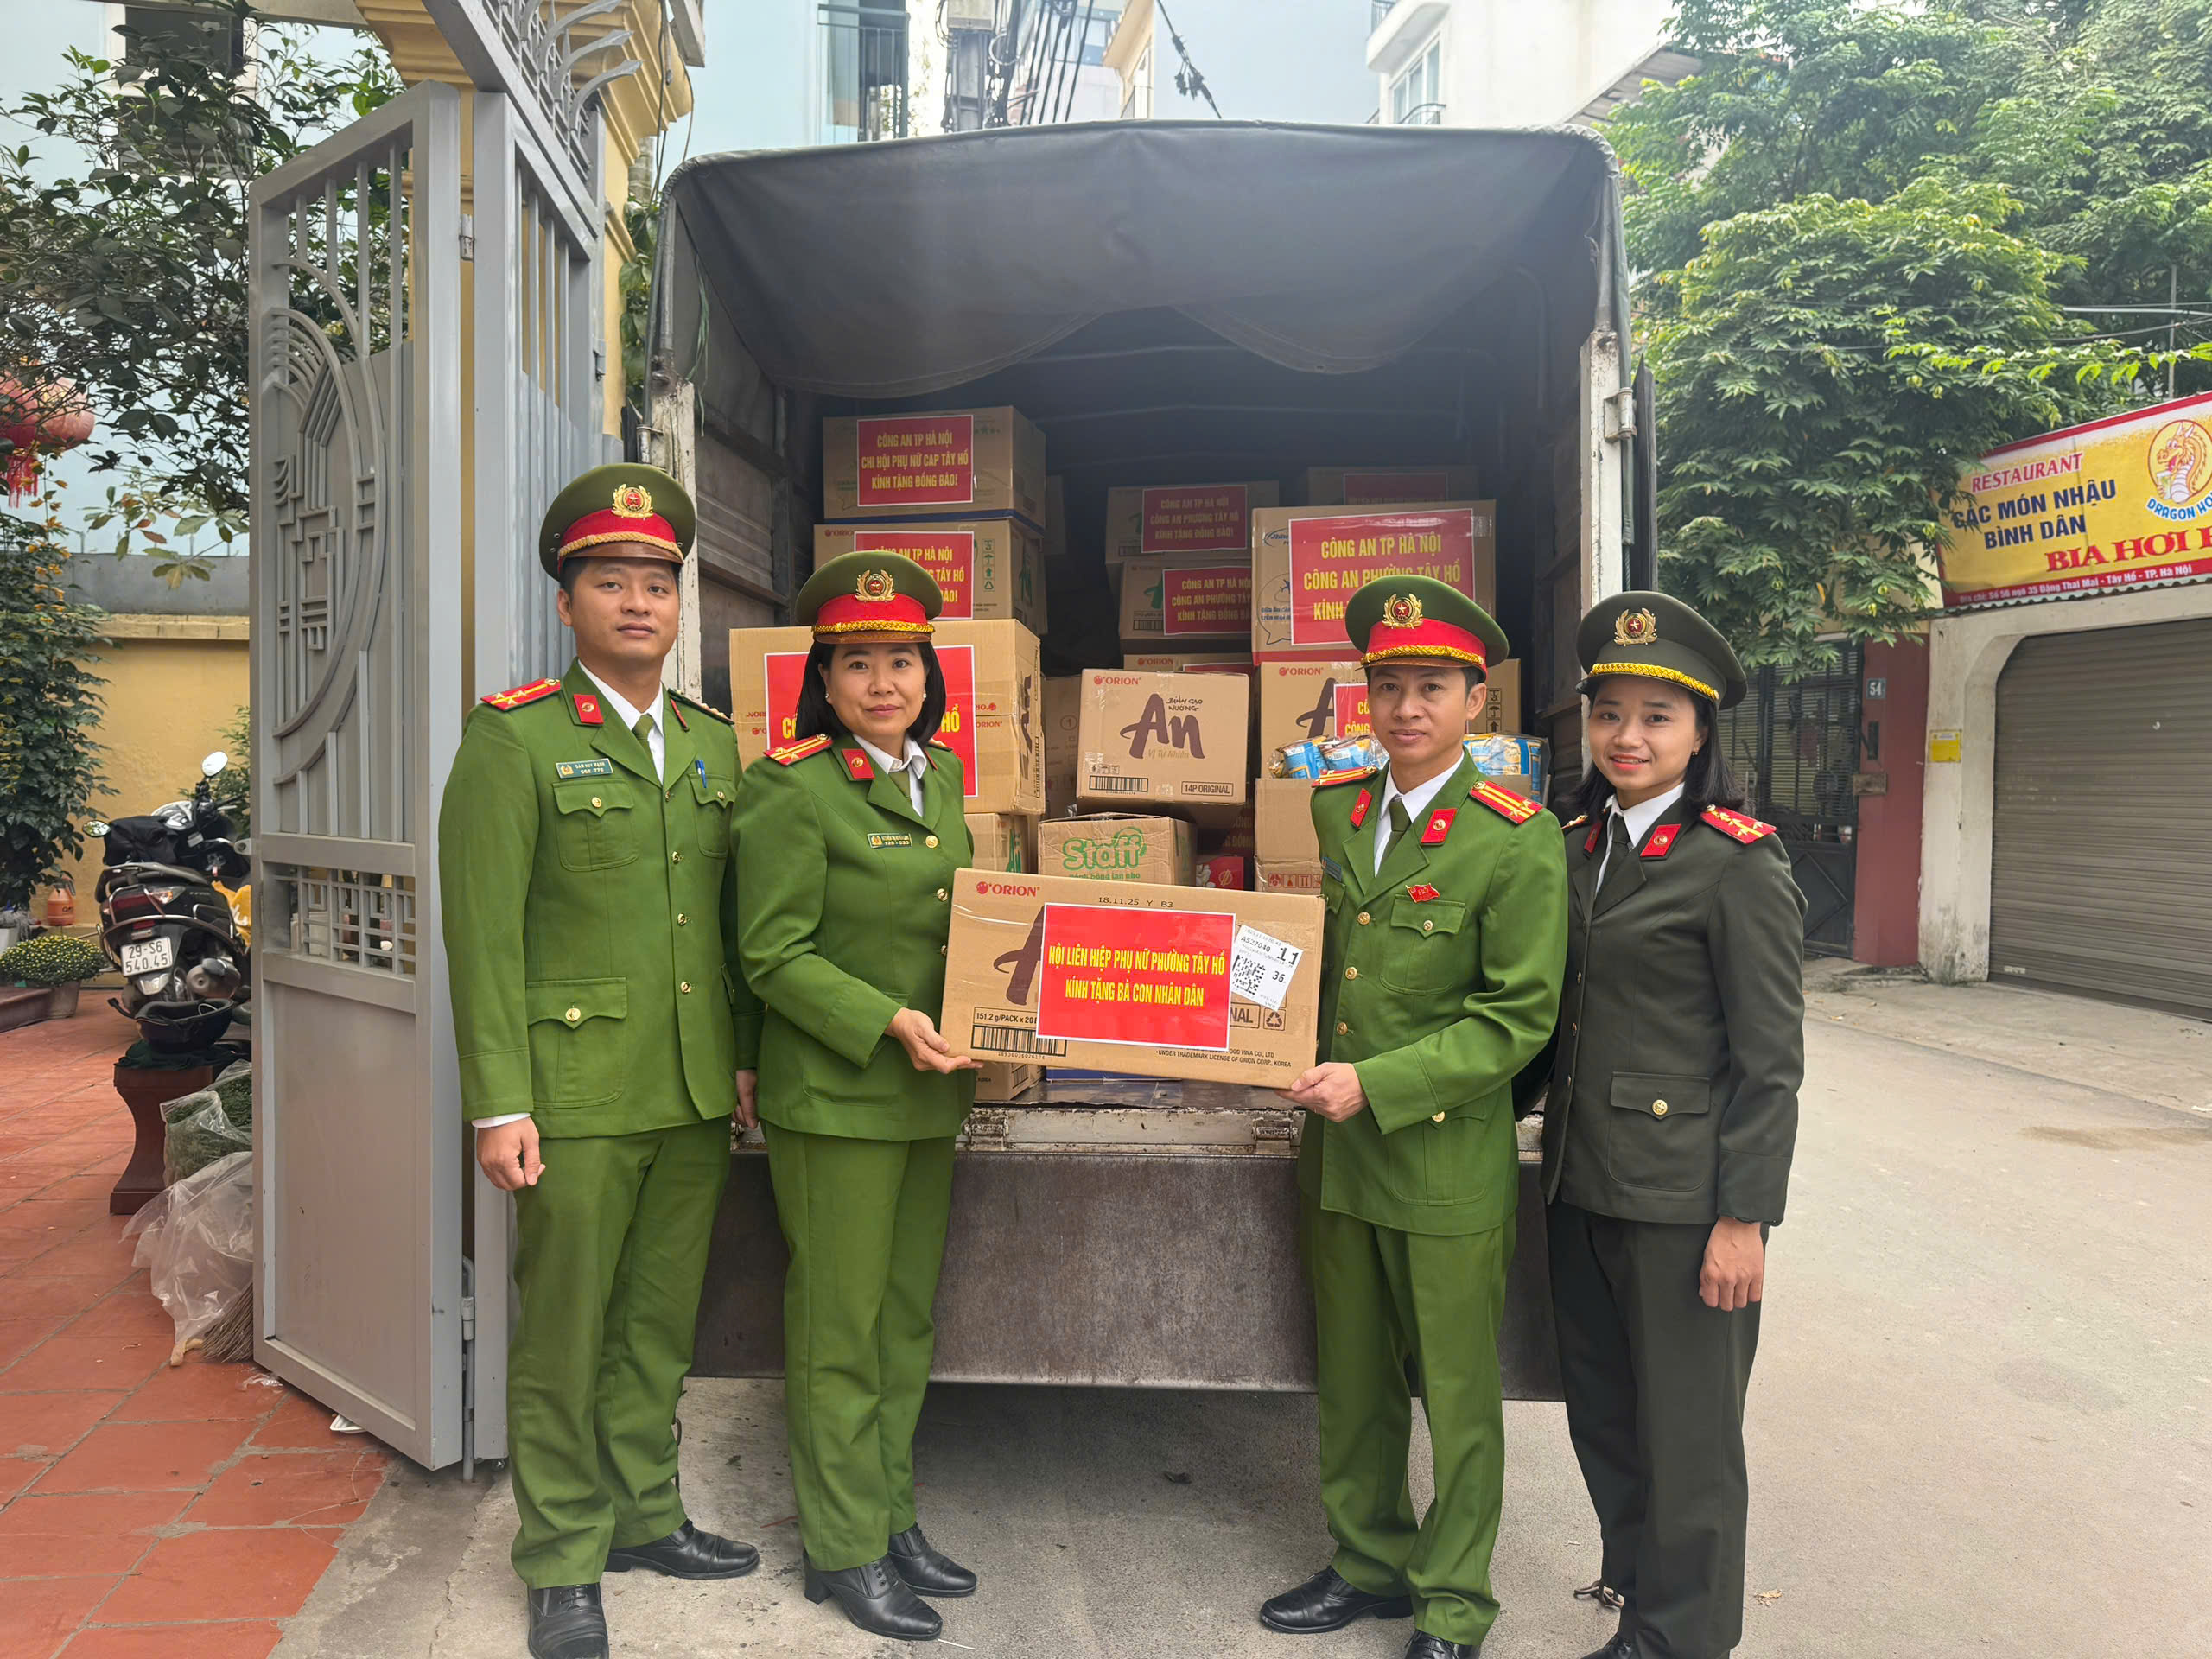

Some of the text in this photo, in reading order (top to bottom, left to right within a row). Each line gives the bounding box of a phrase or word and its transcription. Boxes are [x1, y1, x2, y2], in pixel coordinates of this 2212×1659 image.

[877, 429, 952, 448] CÔNG AN TP HÀ NỘI
[861, 456, 874, 469] CHI
[876, 453, 890, 470] HỘI
[892, 454, 907, 470] PHỤ
[924, 454, 939, 467] CAP
[941, 451, 956, 466] TÂY
[1971, 452, 2083, 493] RESTAURANT
[871, 474, 891, 490] KÍNH
[893, 474, 913, 492] TẶNG
[1998, 493, 2046, 520] MÓN
[2053, 479, 2116, 510] NHẬU
[2147, 492, 2212, 520] DRAGON HO
[1171, 515, 1183, 524] AN
[1984, 514, 2087, 550] BÌNH DÂN
[1321, 531, 1441, 559] CÔNG AN TP HÀ NỘI
[2044, 545, 2109, 572] BIA
[2111, 530, 2191, 563] HƠI
[912, 548, 923, 561] TP
[925, 546, 936, 561] HÀ
[938, 546, 952, 563] NỘI
[936, 568, 951, 582] TÂY
[1304, 568, 1338, 590] CÔNG
[1341, 569, 1359, 588] AN
[1444, 558, 1460, 582] HỒ
[2028, 586, 2038, 594] 35
[2106, 575, 2122, 585] Tây
[2124, 571, 2137, 582] Hồ
[2144, 569, 2158, 580] TP.
[2160, 567, 2173, 577] Hà
[2176, 564, 2192, 576] Nội
[1181, 578, 1202, 590] CÔNG
[1204, 580, 1215, 588] AN
[1216, 579, 1224, 588] TP
[1227, 577, 1237, 588] HÀ
[1172, 594, 1192, 607] CÔNG
[1193, 595, 1204, 605] AN
[1205, 592, 1236, 605] PHƯỜNG
[1177, 610, 1195, 622] KÍNH
[1197, 610, 1217, 623] TẶNG
[1313, 598, 1344, 620] KÍNH
[1289, 667, 1321, 676] ORION
[1105, 677, 1139, 685] ORION
[1869, 681, 1882, 696] 54
[1120, 693, 1205, 759] An
[1185, 784, 1230, 794] 14P ORIGINAL
[1063, 836, 1142, 870] Staff
[992, 884, 1037, 897] ORION
[1098, 896, 1140, 906] 18.11.25
[128, 940, 163, 959] 29-S6
[1241, 936, 1271, 952] A527040
[125, 953, 168, 974] 540.45
[1049, 942, 1065, 969] HỘI
[1066, 943, 1088, 967] LIÊN
[1090, 944, 1112, 972] HIỆP
[1114, 950, 1134, 974] PHỤ
[1135, 947, 1150, 970] NỮ
[1151, 948, 1190, 974] PHƯỜNG
[1192, 950, 1210, 975] TÂY
[1211, 950, 1225, 976] HỒ
[1276, 947, 1299, 965] 11
[1272, 970, 1286, 983] 36
[1065, 975, 1205, 1007] KÍNH TẶNG BÀ CON NHÂN DÂN
[976, 1012, 994, 1020] 151.2
[995, 1014, 1019, 1023] g/PACK
[1177, 1051, 1208, 1060] TRADEMARK
[1209, 1053, 1230, 1062] LICENSE
